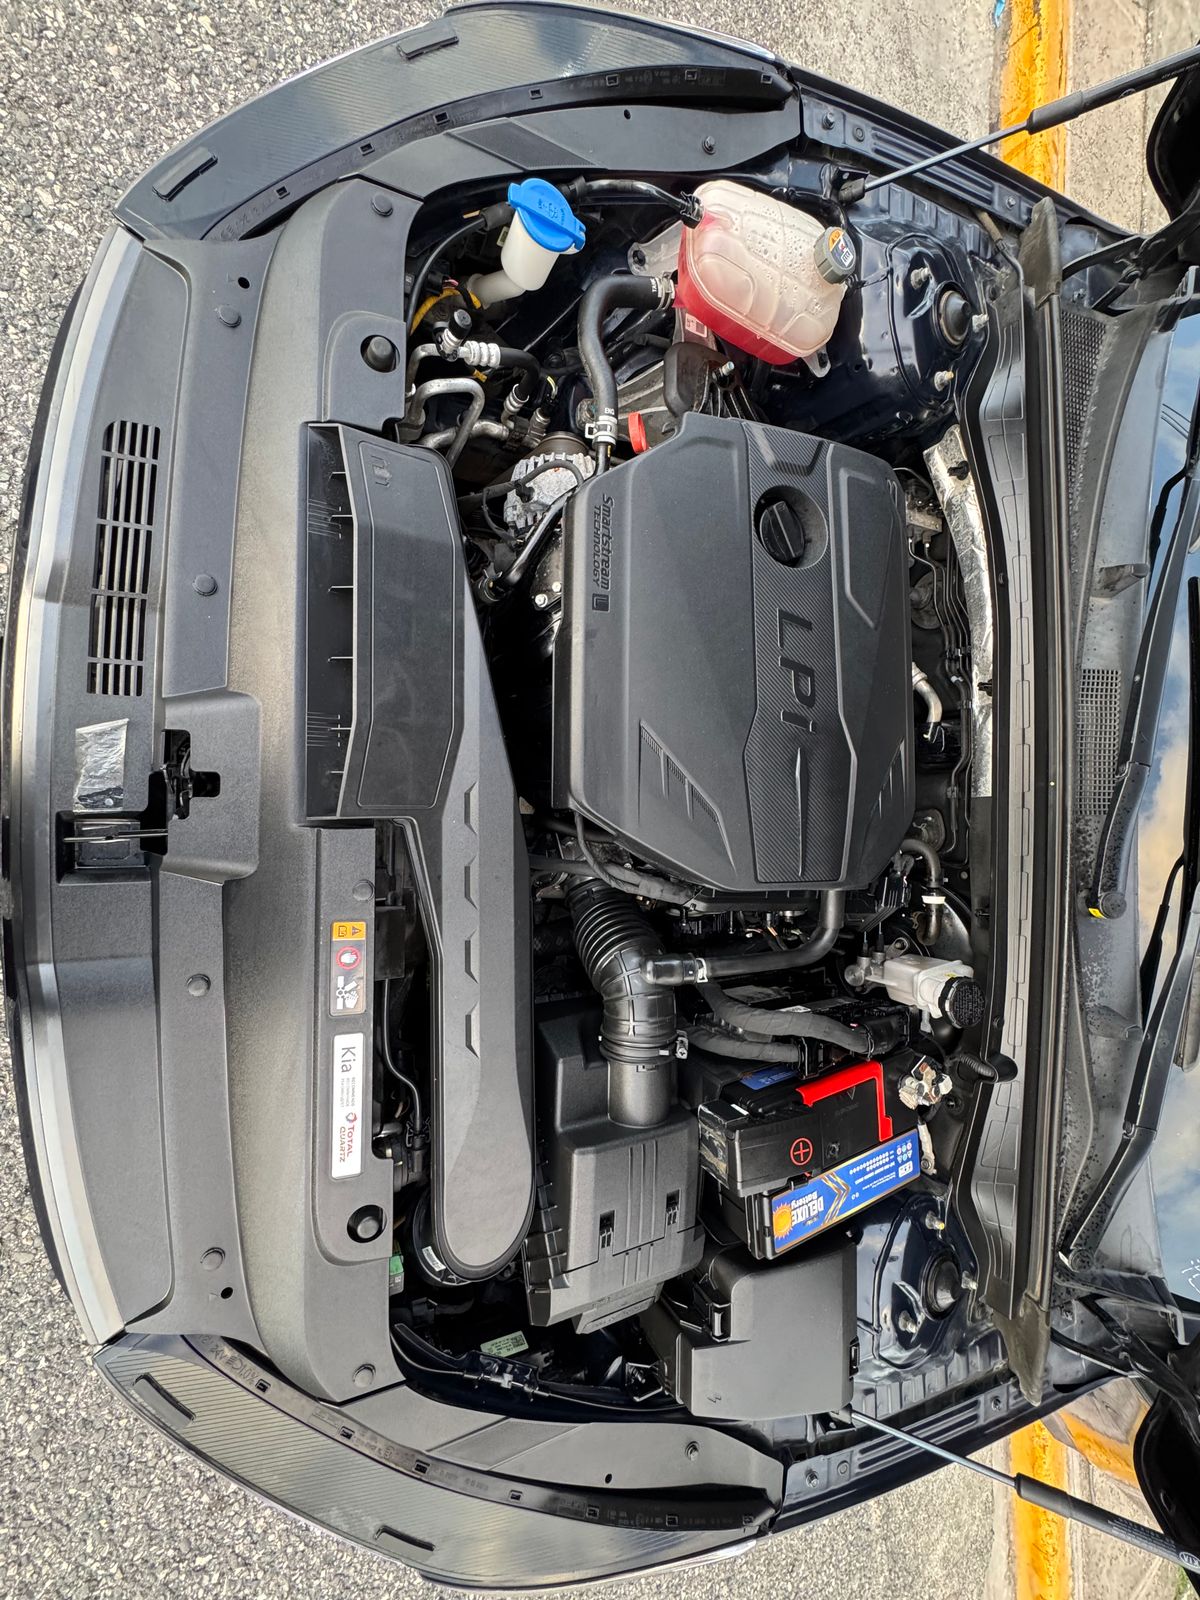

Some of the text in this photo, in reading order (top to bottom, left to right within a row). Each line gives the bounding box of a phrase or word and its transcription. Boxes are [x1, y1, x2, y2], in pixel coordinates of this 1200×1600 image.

[593, 505, 601, 587] TECHNOLOGY
[601, 494, 614, 591] Smartstream
[340, 1046, 356, 1073] Kia
[346, 1125, 355, 1157] TOTAL
